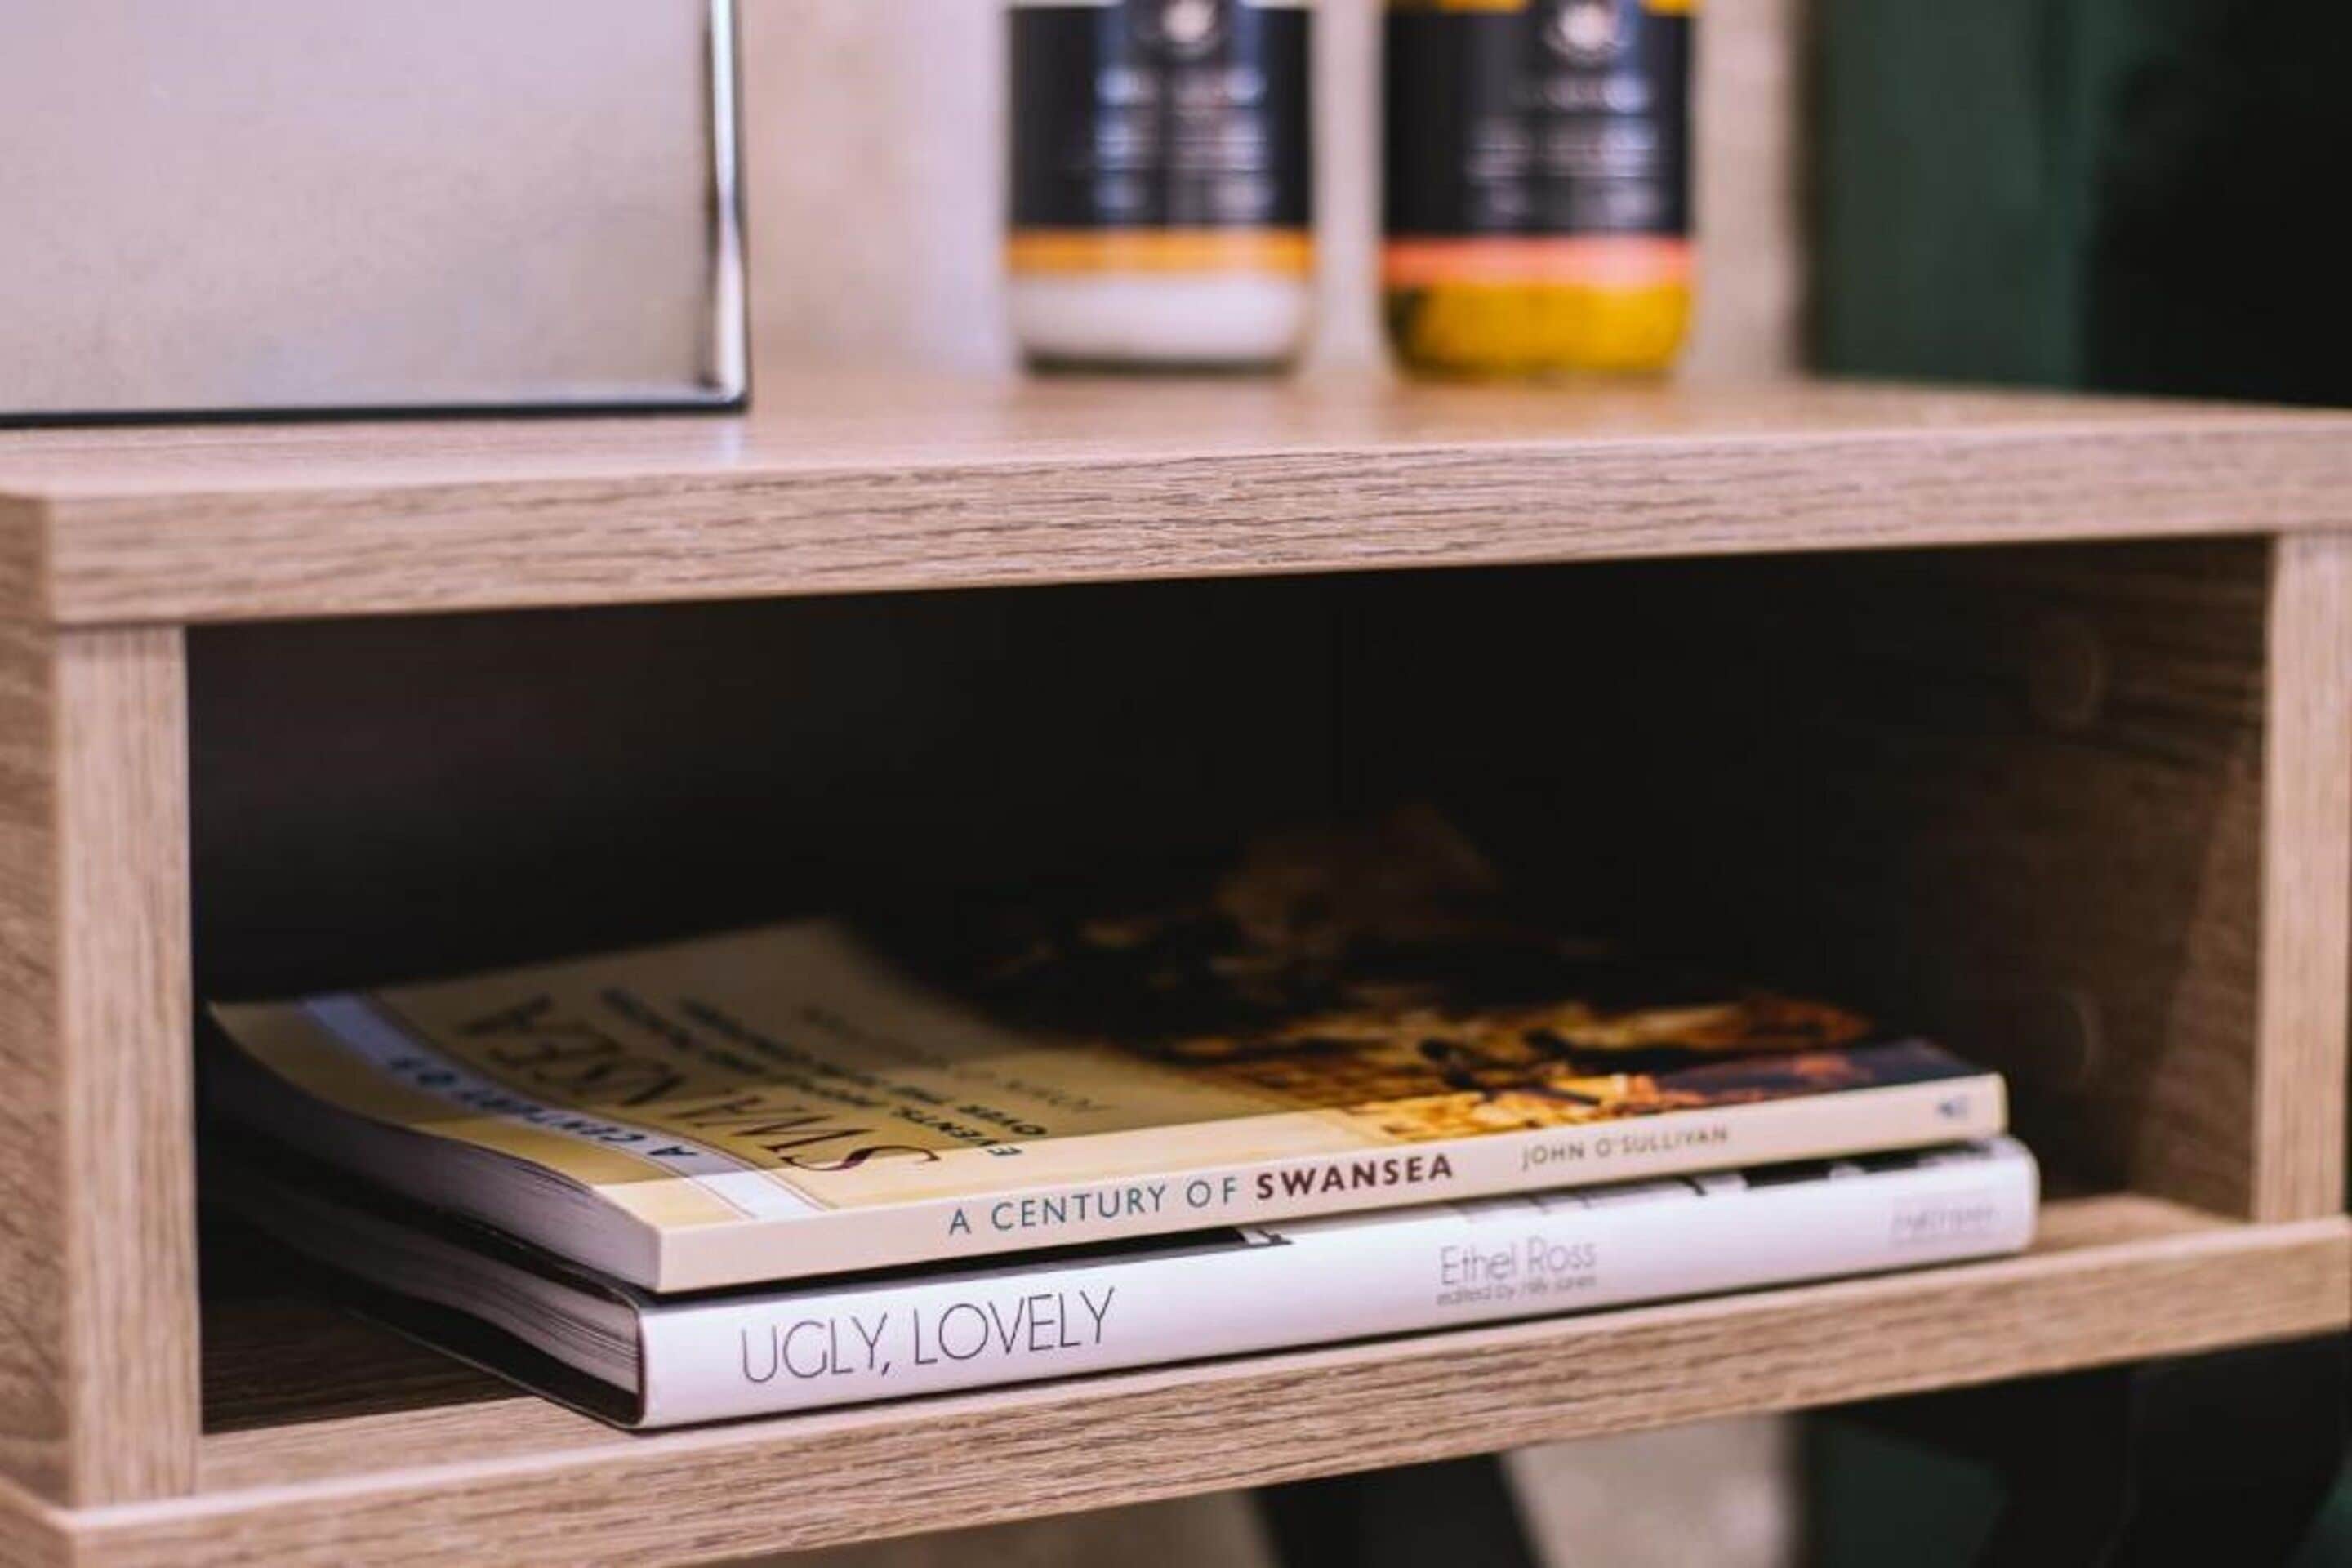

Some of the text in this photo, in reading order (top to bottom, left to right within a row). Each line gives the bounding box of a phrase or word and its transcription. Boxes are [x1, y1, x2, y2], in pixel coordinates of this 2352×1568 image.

[648, 1145, 699, 1158] A
[1522, 1140, 1585, 1171] JOHN
[949, 1152, 1454, 1236] A CENTURY OF SWANSEA
[1439, 1235, 1596, 1285] Ethel Ross
[741, 1285, 1116, 1383] UGLY, LOVELY
